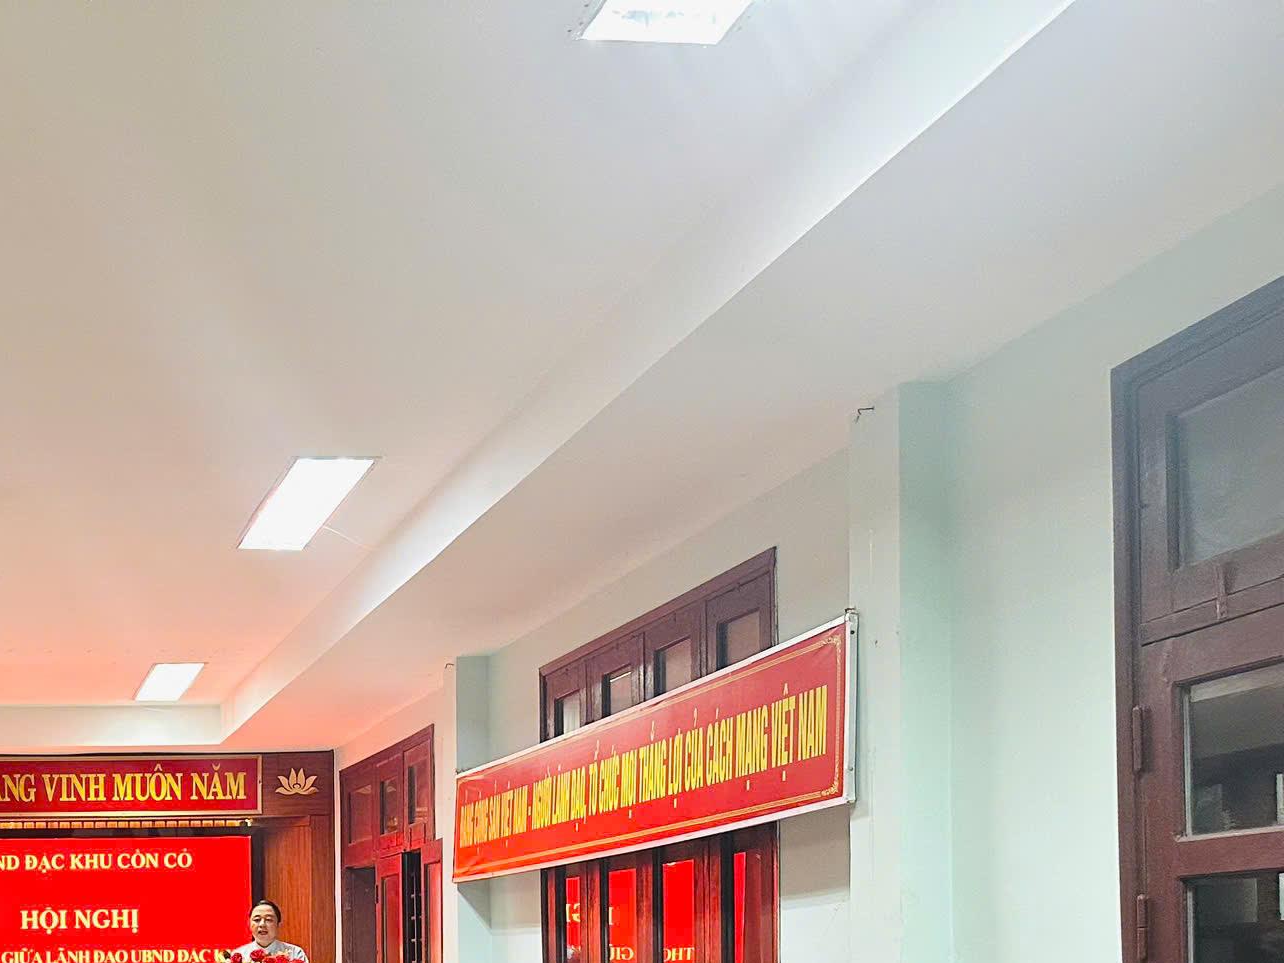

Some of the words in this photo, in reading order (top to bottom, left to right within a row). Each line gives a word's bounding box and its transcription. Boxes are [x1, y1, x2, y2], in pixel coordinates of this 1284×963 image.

[513, 785, 528, 834] NAM
[552, 764, 571, 825] LÃNH
[588, 739, 599, 816] TỔ
[598, 744, 620, 814] CHỨC
[620, 750, 636, 819] MỌI
[639, 721, 667, 803] THẮNG
[668, 728, 683, 808] LỢI
[684, 707, 704, 792] CỦA
[706, 707, 733, 787] CÁCH
[735, 705, 769, 791] MẠNG
[771, 682, 796, 782] VIỆT
[797, 684, 828, 761] NAM
[42, 774, 106, 802] VINH
[112, 764, 182, 801] MUÔN
[190, 764, 246, 800] NĂM
[69, 853, 113, 870] KHU
[20, 907, 69, 934] HỘI
[74, 908, 139, 933] NGHỊ
[46, 947, 90, 963] LÃNH
[131, 949, 175, 963] UBND
